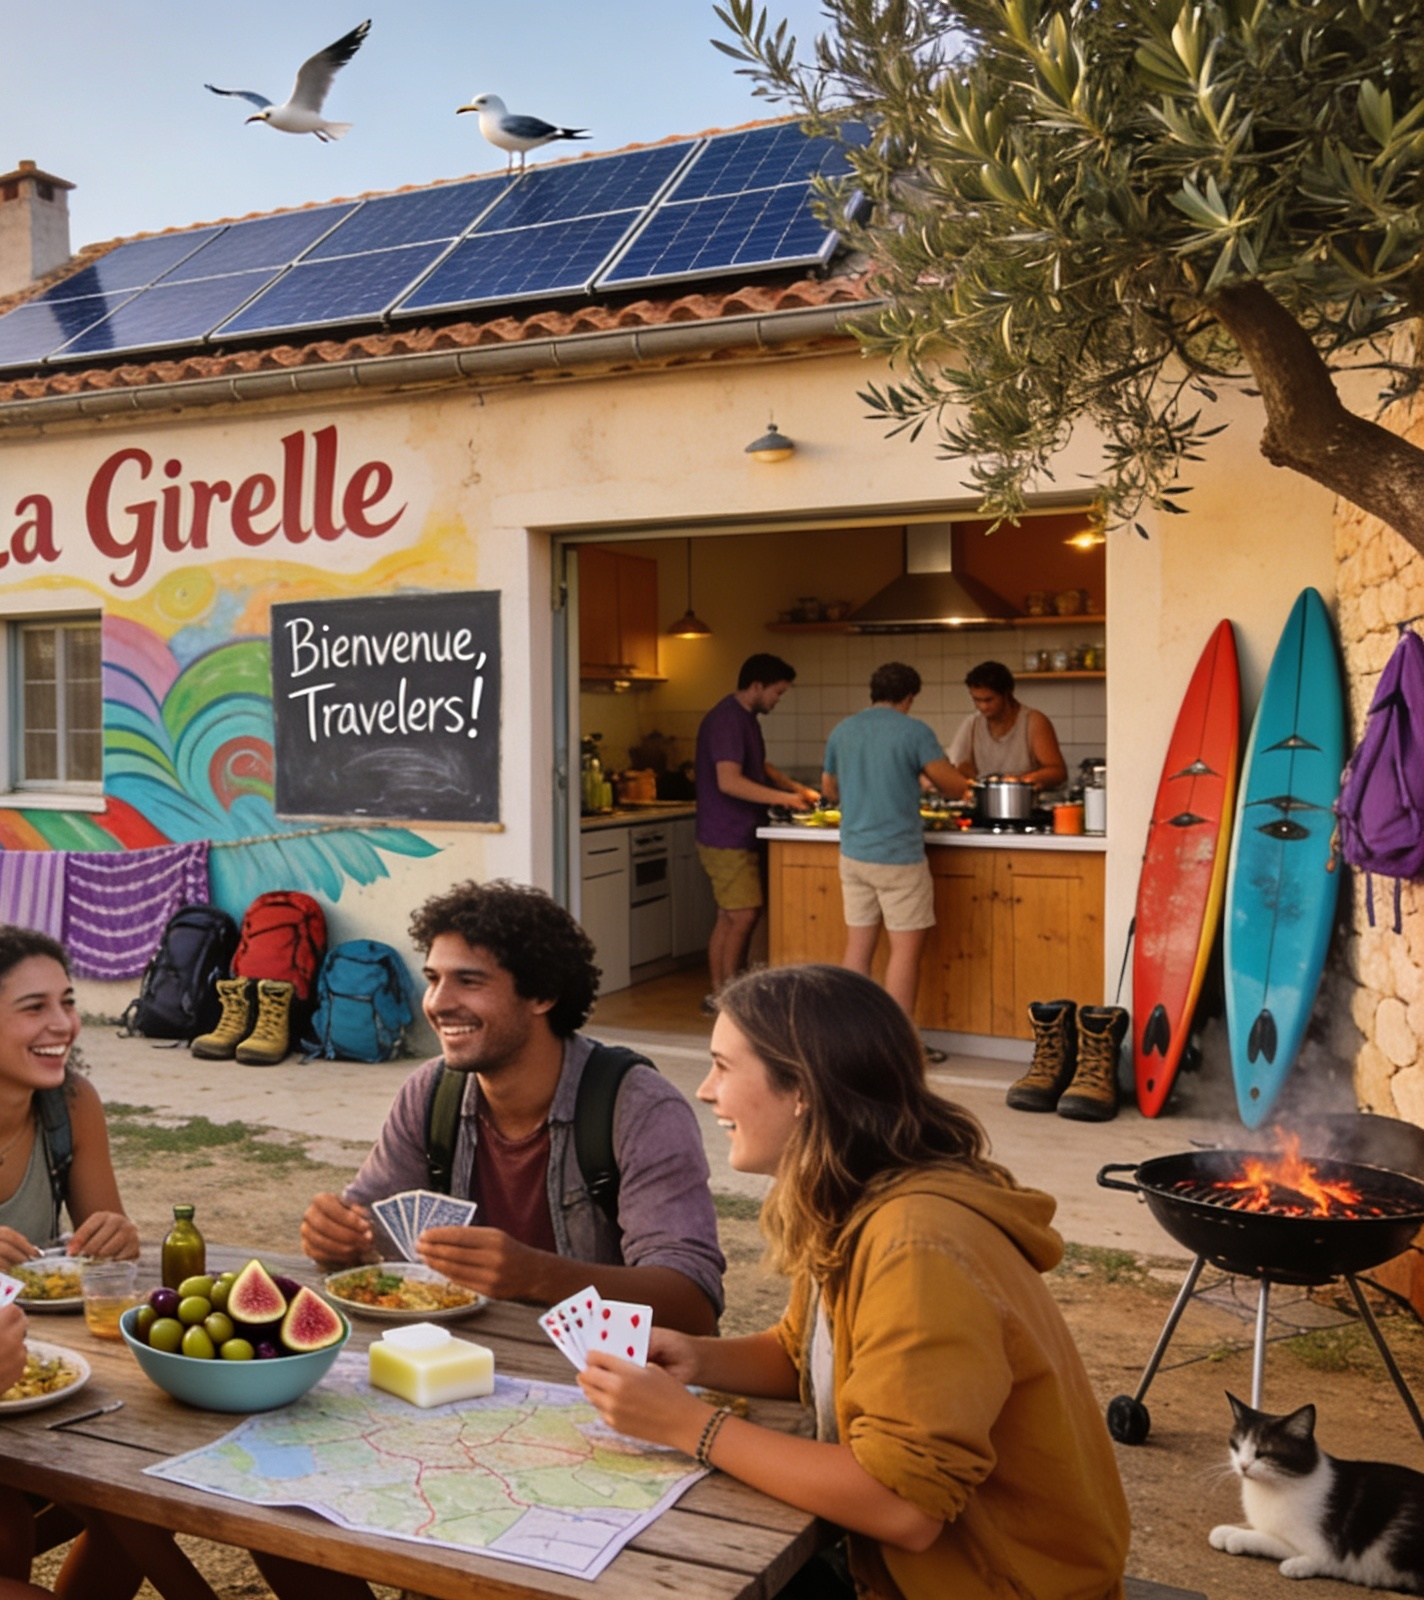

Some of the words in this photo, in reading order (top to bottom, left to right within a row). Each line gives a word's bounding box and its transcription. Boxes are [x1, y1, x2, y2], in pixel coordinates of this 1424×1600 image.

[85, 425, 408, 588] Girelle
[285, 617, 487, 678] Bienvenue,
[288, 676, 484, 743] Travelers!
